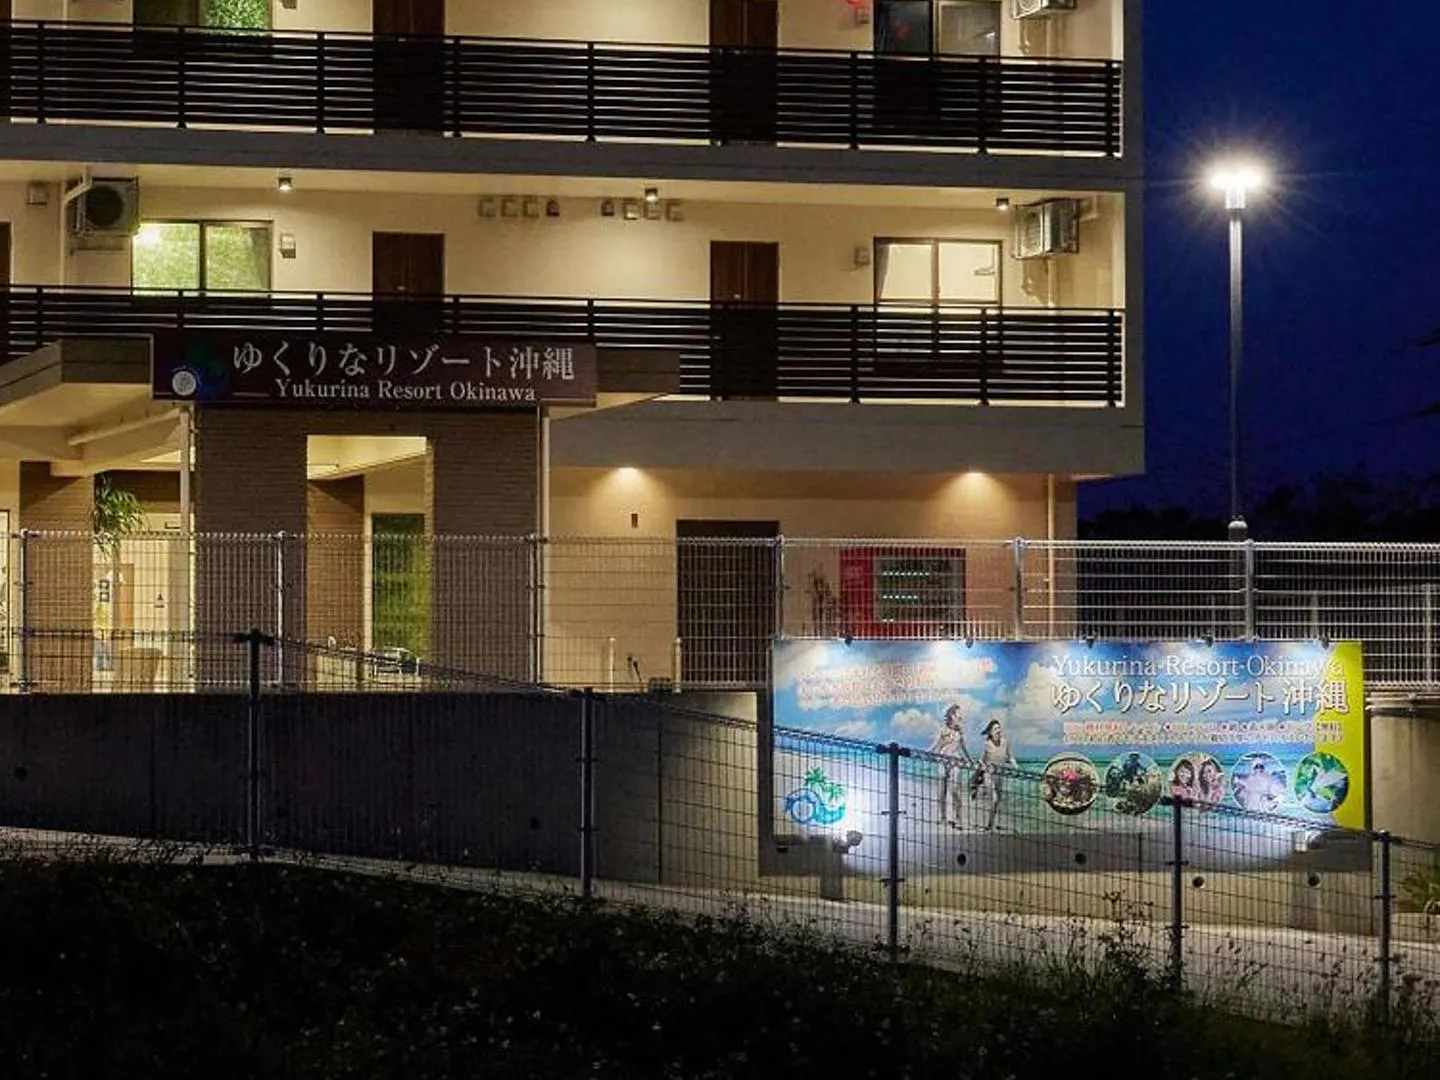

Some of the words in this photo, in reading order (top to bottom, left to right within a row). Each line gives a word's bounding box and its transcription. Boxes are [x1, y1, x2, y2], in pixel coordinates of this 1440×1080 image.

[233, 343, 575, 381] ゆくりなリゾート沖縄
[275, 379, 370, 399] Yukurina
[378, 382, 442, 400] Resort
[450, 381, 536, 402] Okinawa
[1051, 680, 1349, 714] ゆくりなリゾート沖縄
